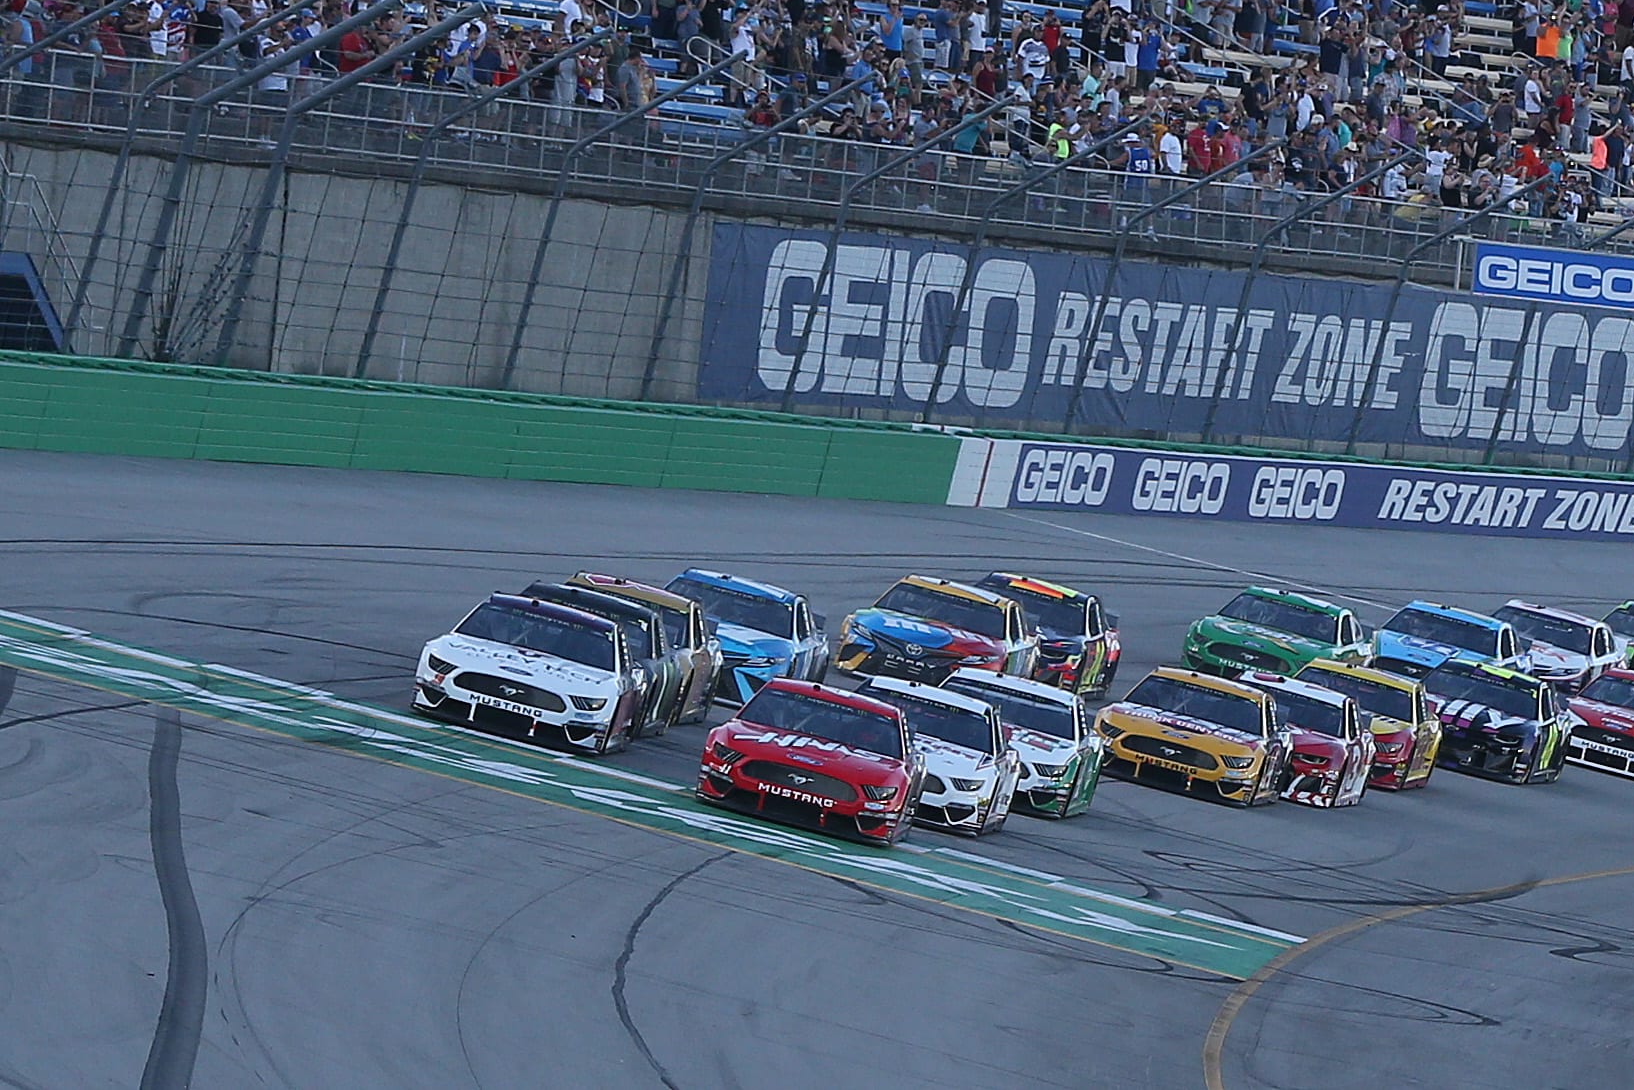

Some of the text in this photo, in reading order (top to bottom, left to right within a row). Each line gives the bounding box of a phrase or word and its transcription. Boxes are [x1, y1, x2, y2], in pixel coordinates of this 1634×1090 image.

[757, 239, 1036, 408] GEICO
[1042, 291, 1266, 400] RESTART
[1270, 311, 1412, 410] ZONE
[1016, 449, 1115, 506] GEICO
[1132, 457, 1231, 514] GEICO
[1248, 465, 1345, 521] GEICO
[1377, 479, 1540, 531] RESTART
[469, 693, 544, 718] MUSTANG
[1135, 754, 1198, 775] MUSTANG
[758, 782, 834, 808] MUSTANG
